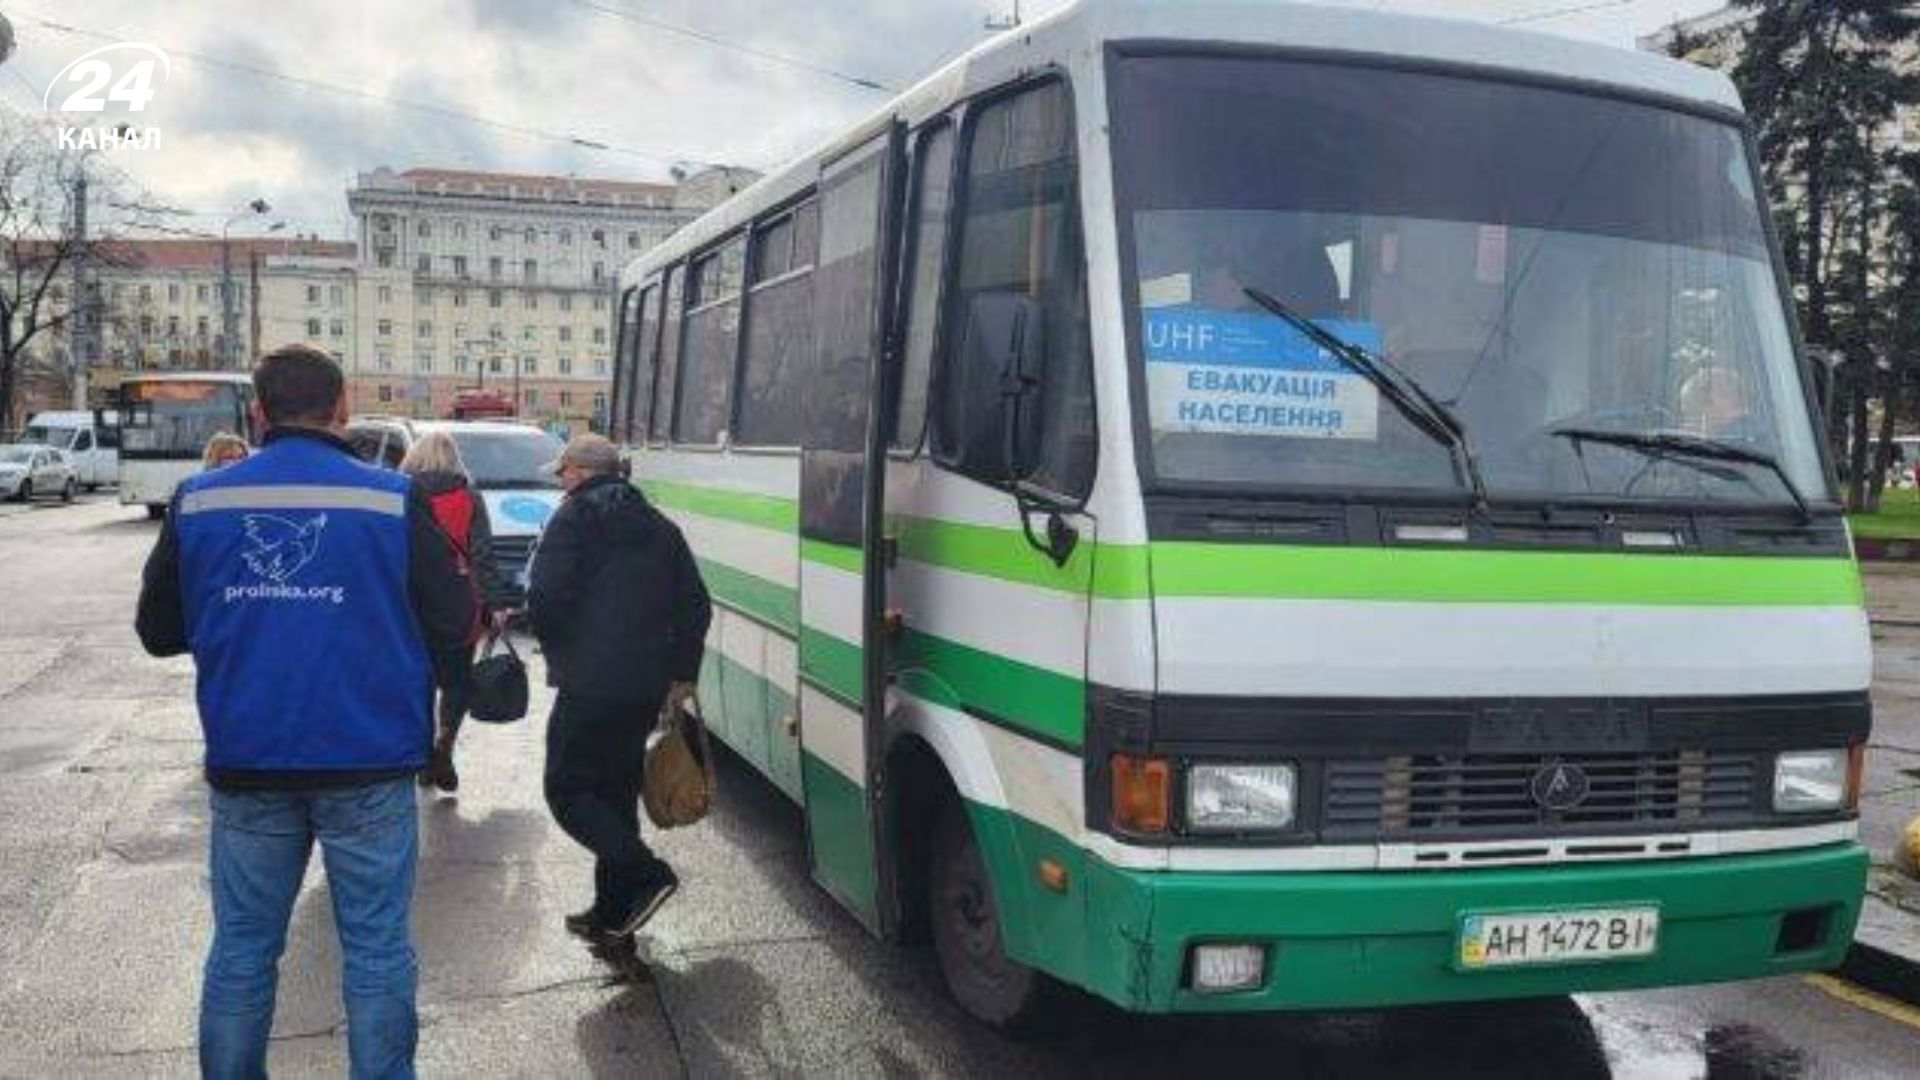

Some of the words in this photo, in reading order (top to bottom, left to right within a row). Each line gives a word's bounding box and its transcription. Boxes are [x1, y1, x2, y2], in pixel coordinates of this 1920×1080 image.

[1147, 321, 1214, 351] UHF
[1187, 370, 1336, 401] ЕВАКУАЦІЯ
[1178, 401, 1342, 429] НАСЕЛЕННЯ
[1486, 924, 1528, 956] AH
[1537, 919, 1600, 953] 1472
